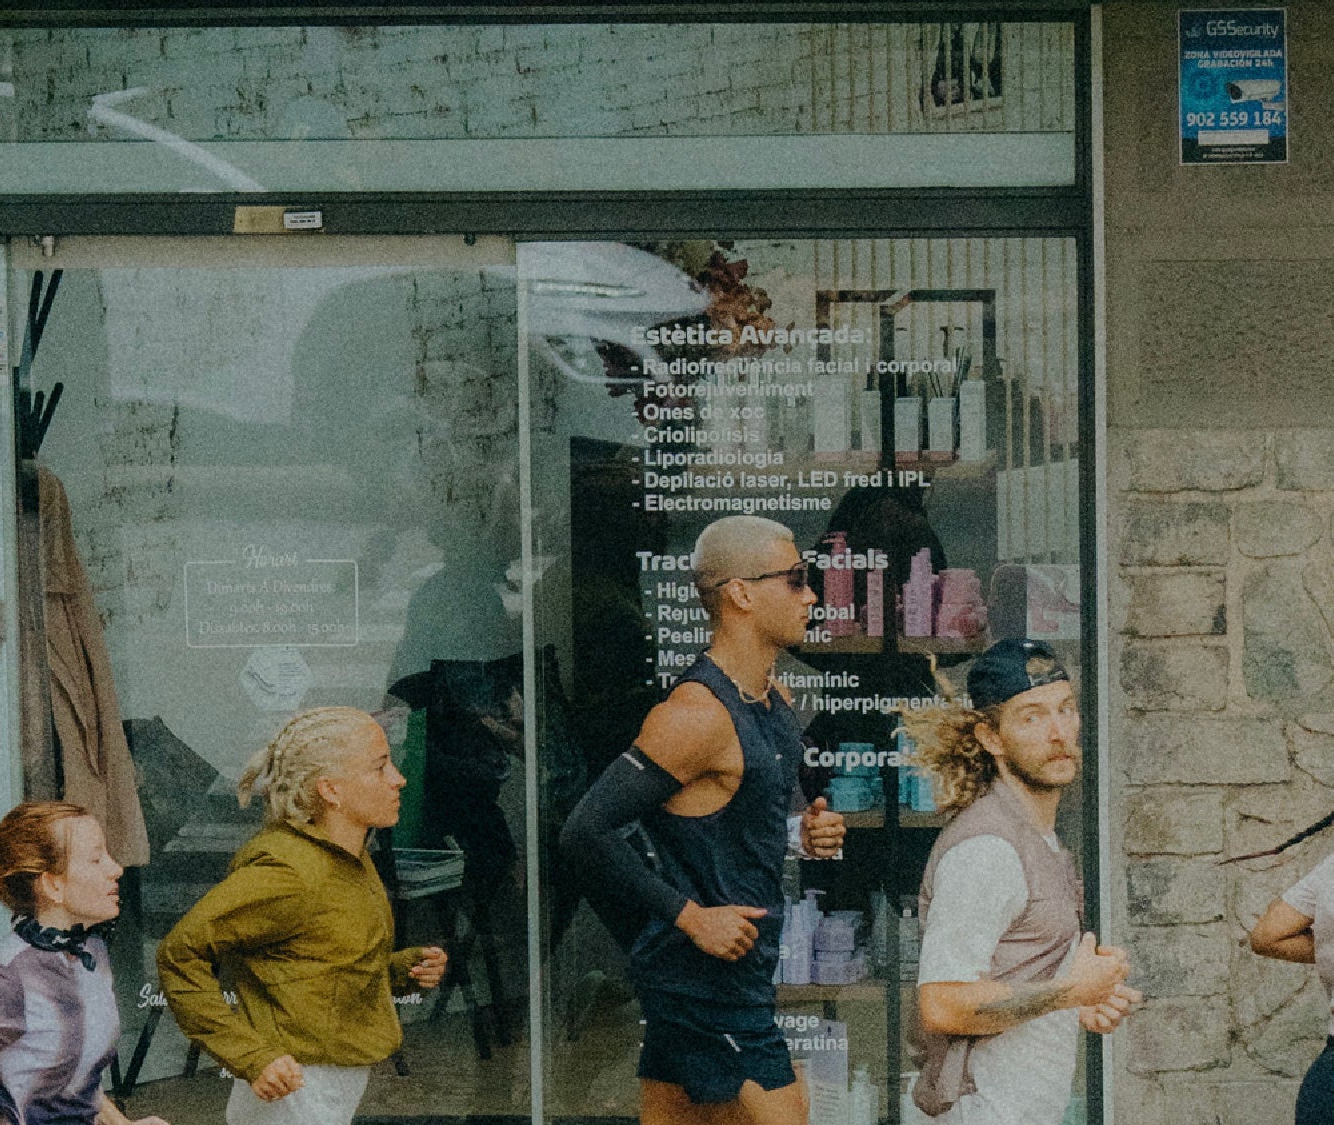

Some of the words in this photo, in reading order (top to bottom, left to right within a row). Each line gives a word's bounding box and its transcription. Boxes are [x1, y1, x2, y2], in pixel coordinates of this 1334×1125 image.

[1186, 112, 1215, 127] 902
[1219, 112, 1248, 127] 559
[1254, 111, 1282, 126] 184
[631, 323, 733, 345] Estètica
[642, 357, 801, 380] Radiofreqüència
[807, 357, 859, 373] facial
[876, 357, 957, 378] corporal
[643, 381, 816, 400] Fotorejuveniment
[643, 403, 695, 420] Ones
[700, 403, 724, 420] de
[730, 406, 765, 420] xoc
[644, 450, 784, 469] Liporadiologia
[644, 471, 734, 491] Depilació
[740, 471, 792, 491] laser,
[798, 470, 838, 487] LED
[842, 470, 882, 487] fred
[887, 470, 893, 487] i
[898, 470, 931, 487] IPL
[644, 494, 832, 514] Electromagnetisme
[801, 548, 889, 569] Facials
